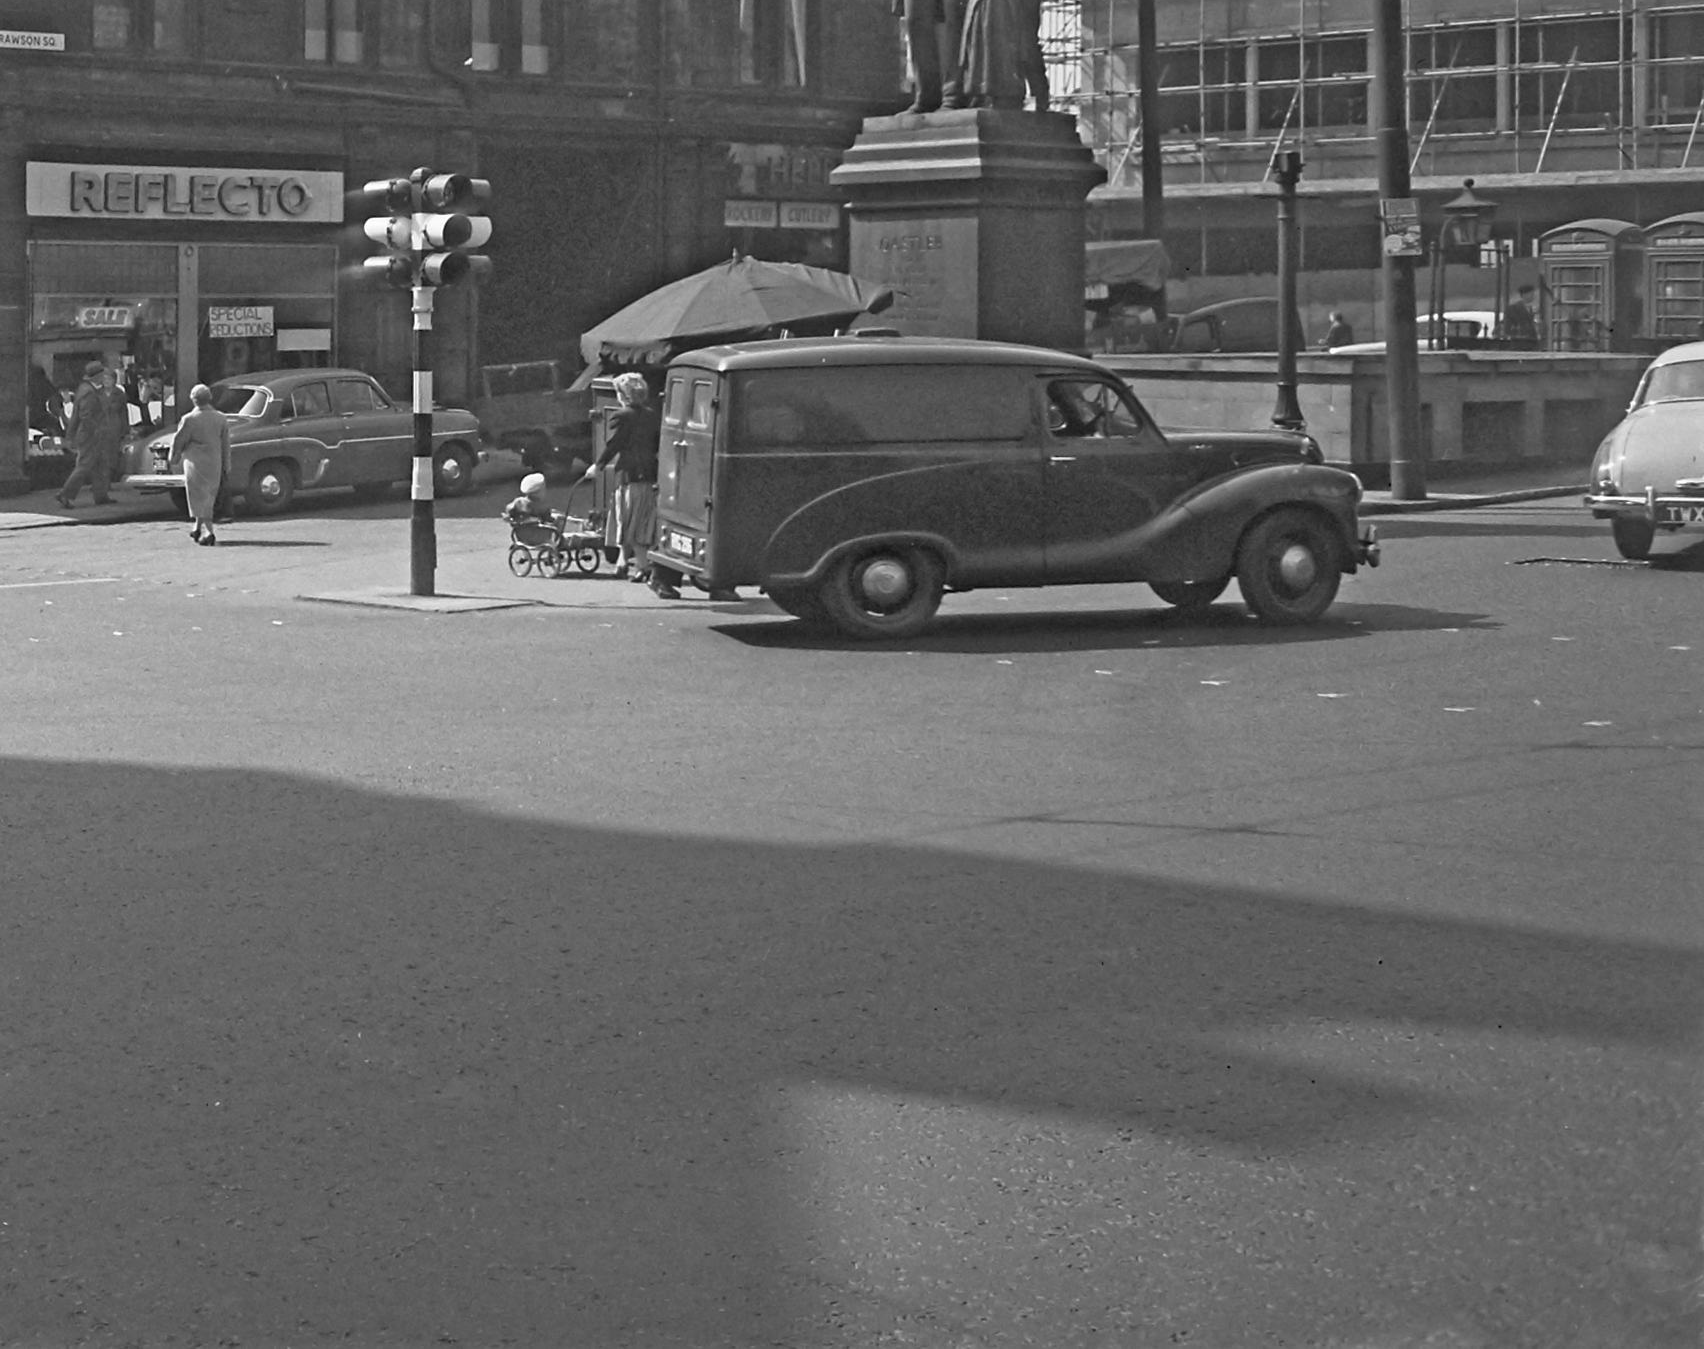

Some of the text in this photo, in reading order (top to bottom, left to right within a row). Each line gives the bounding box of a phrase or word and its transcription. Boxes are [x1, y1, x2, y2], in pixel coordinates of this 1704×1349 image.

[69, 171, 311, 216] REFLECTO
[83, 309, 128, 326] SALE
[210, 307, 263, 322] SPECIAL
[210, 322, 273, 336] REDUCTIONS
